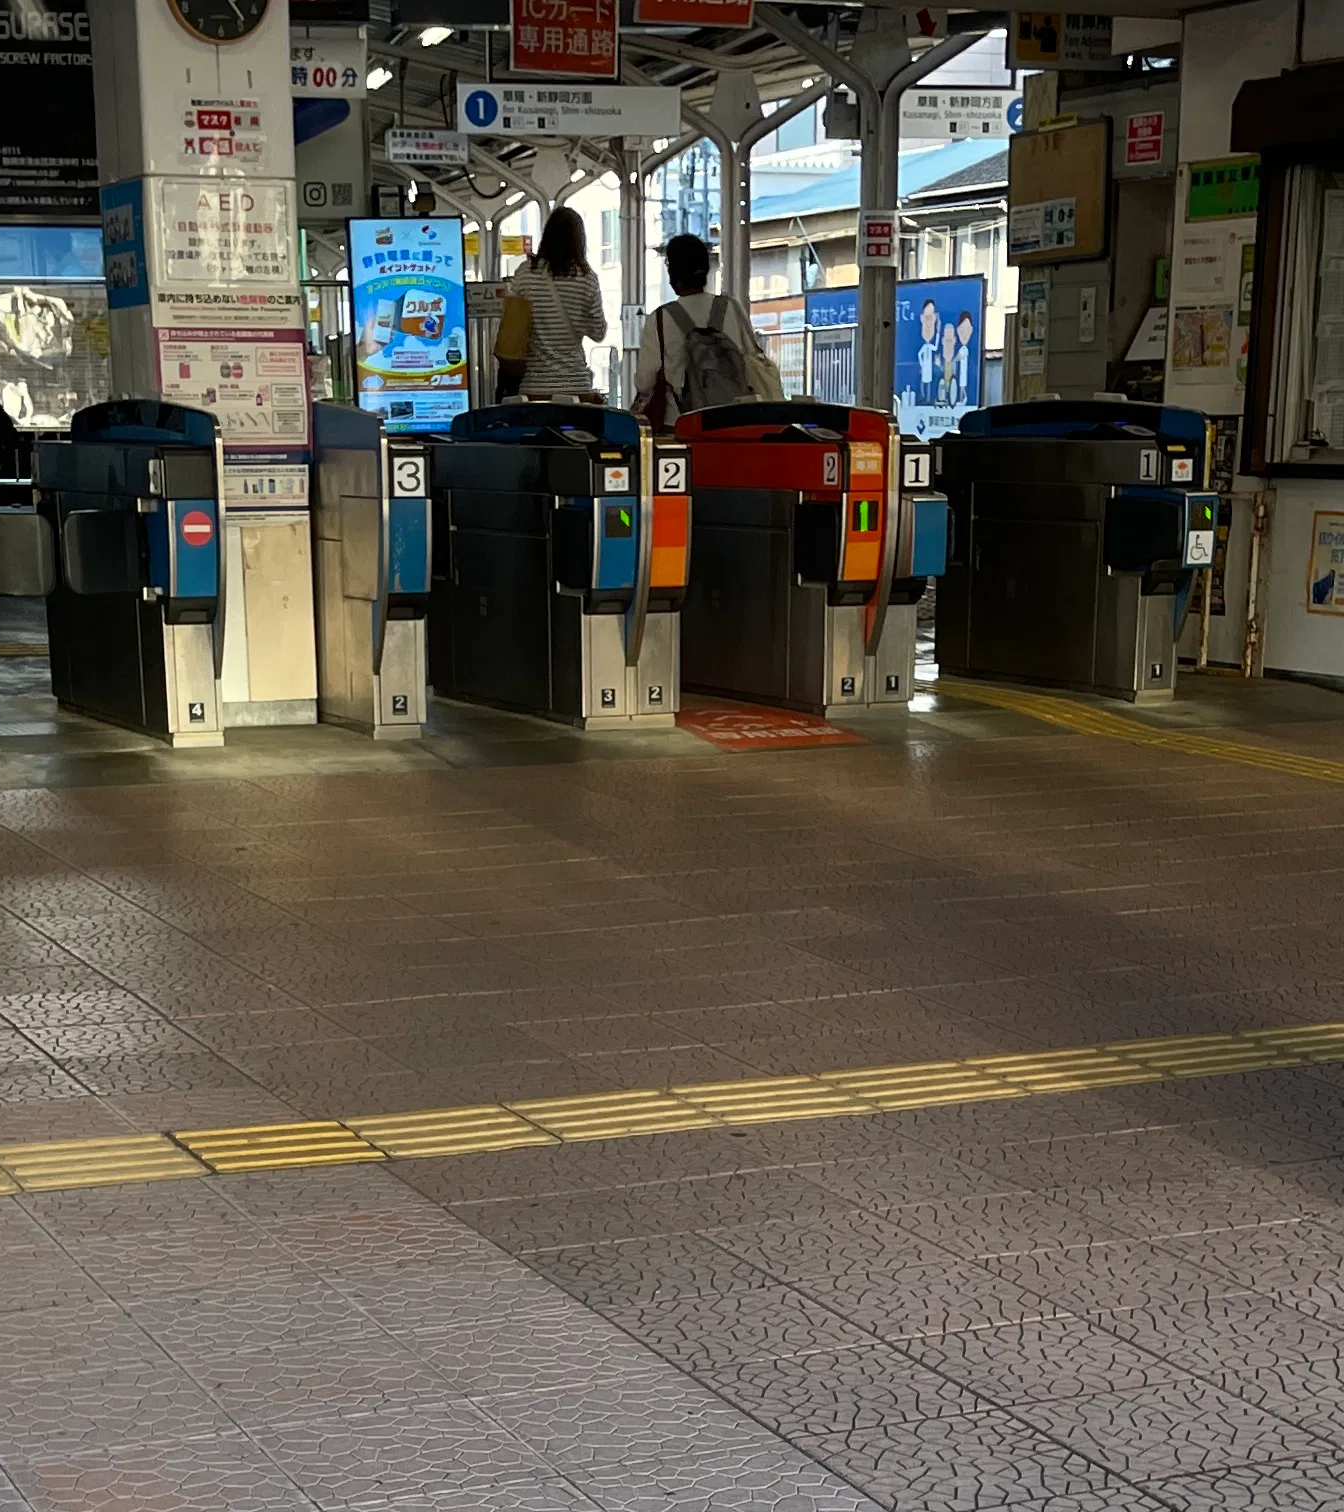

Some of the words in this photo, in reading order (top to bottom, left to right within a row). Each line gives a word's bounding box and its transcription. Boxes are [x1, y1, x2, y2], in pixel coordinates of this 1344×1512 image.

[200, 114, 228, 126] マスク
[197, 193, 255, 212] AED
[826, 455, 836, 483] 2
[909, 456, 925, 485] 1
[1142, 452, 1153, 478] 1
[396, 461, 422, 492] 3
[662, 461, 682, 489] 2
[649, 686, 661, 699] 2
[843, 678, 853, 691] 2
[394, 695, 405, 710] 2
[603, 689, 614, 703] 3
[191, 702, 204, 717] 4
